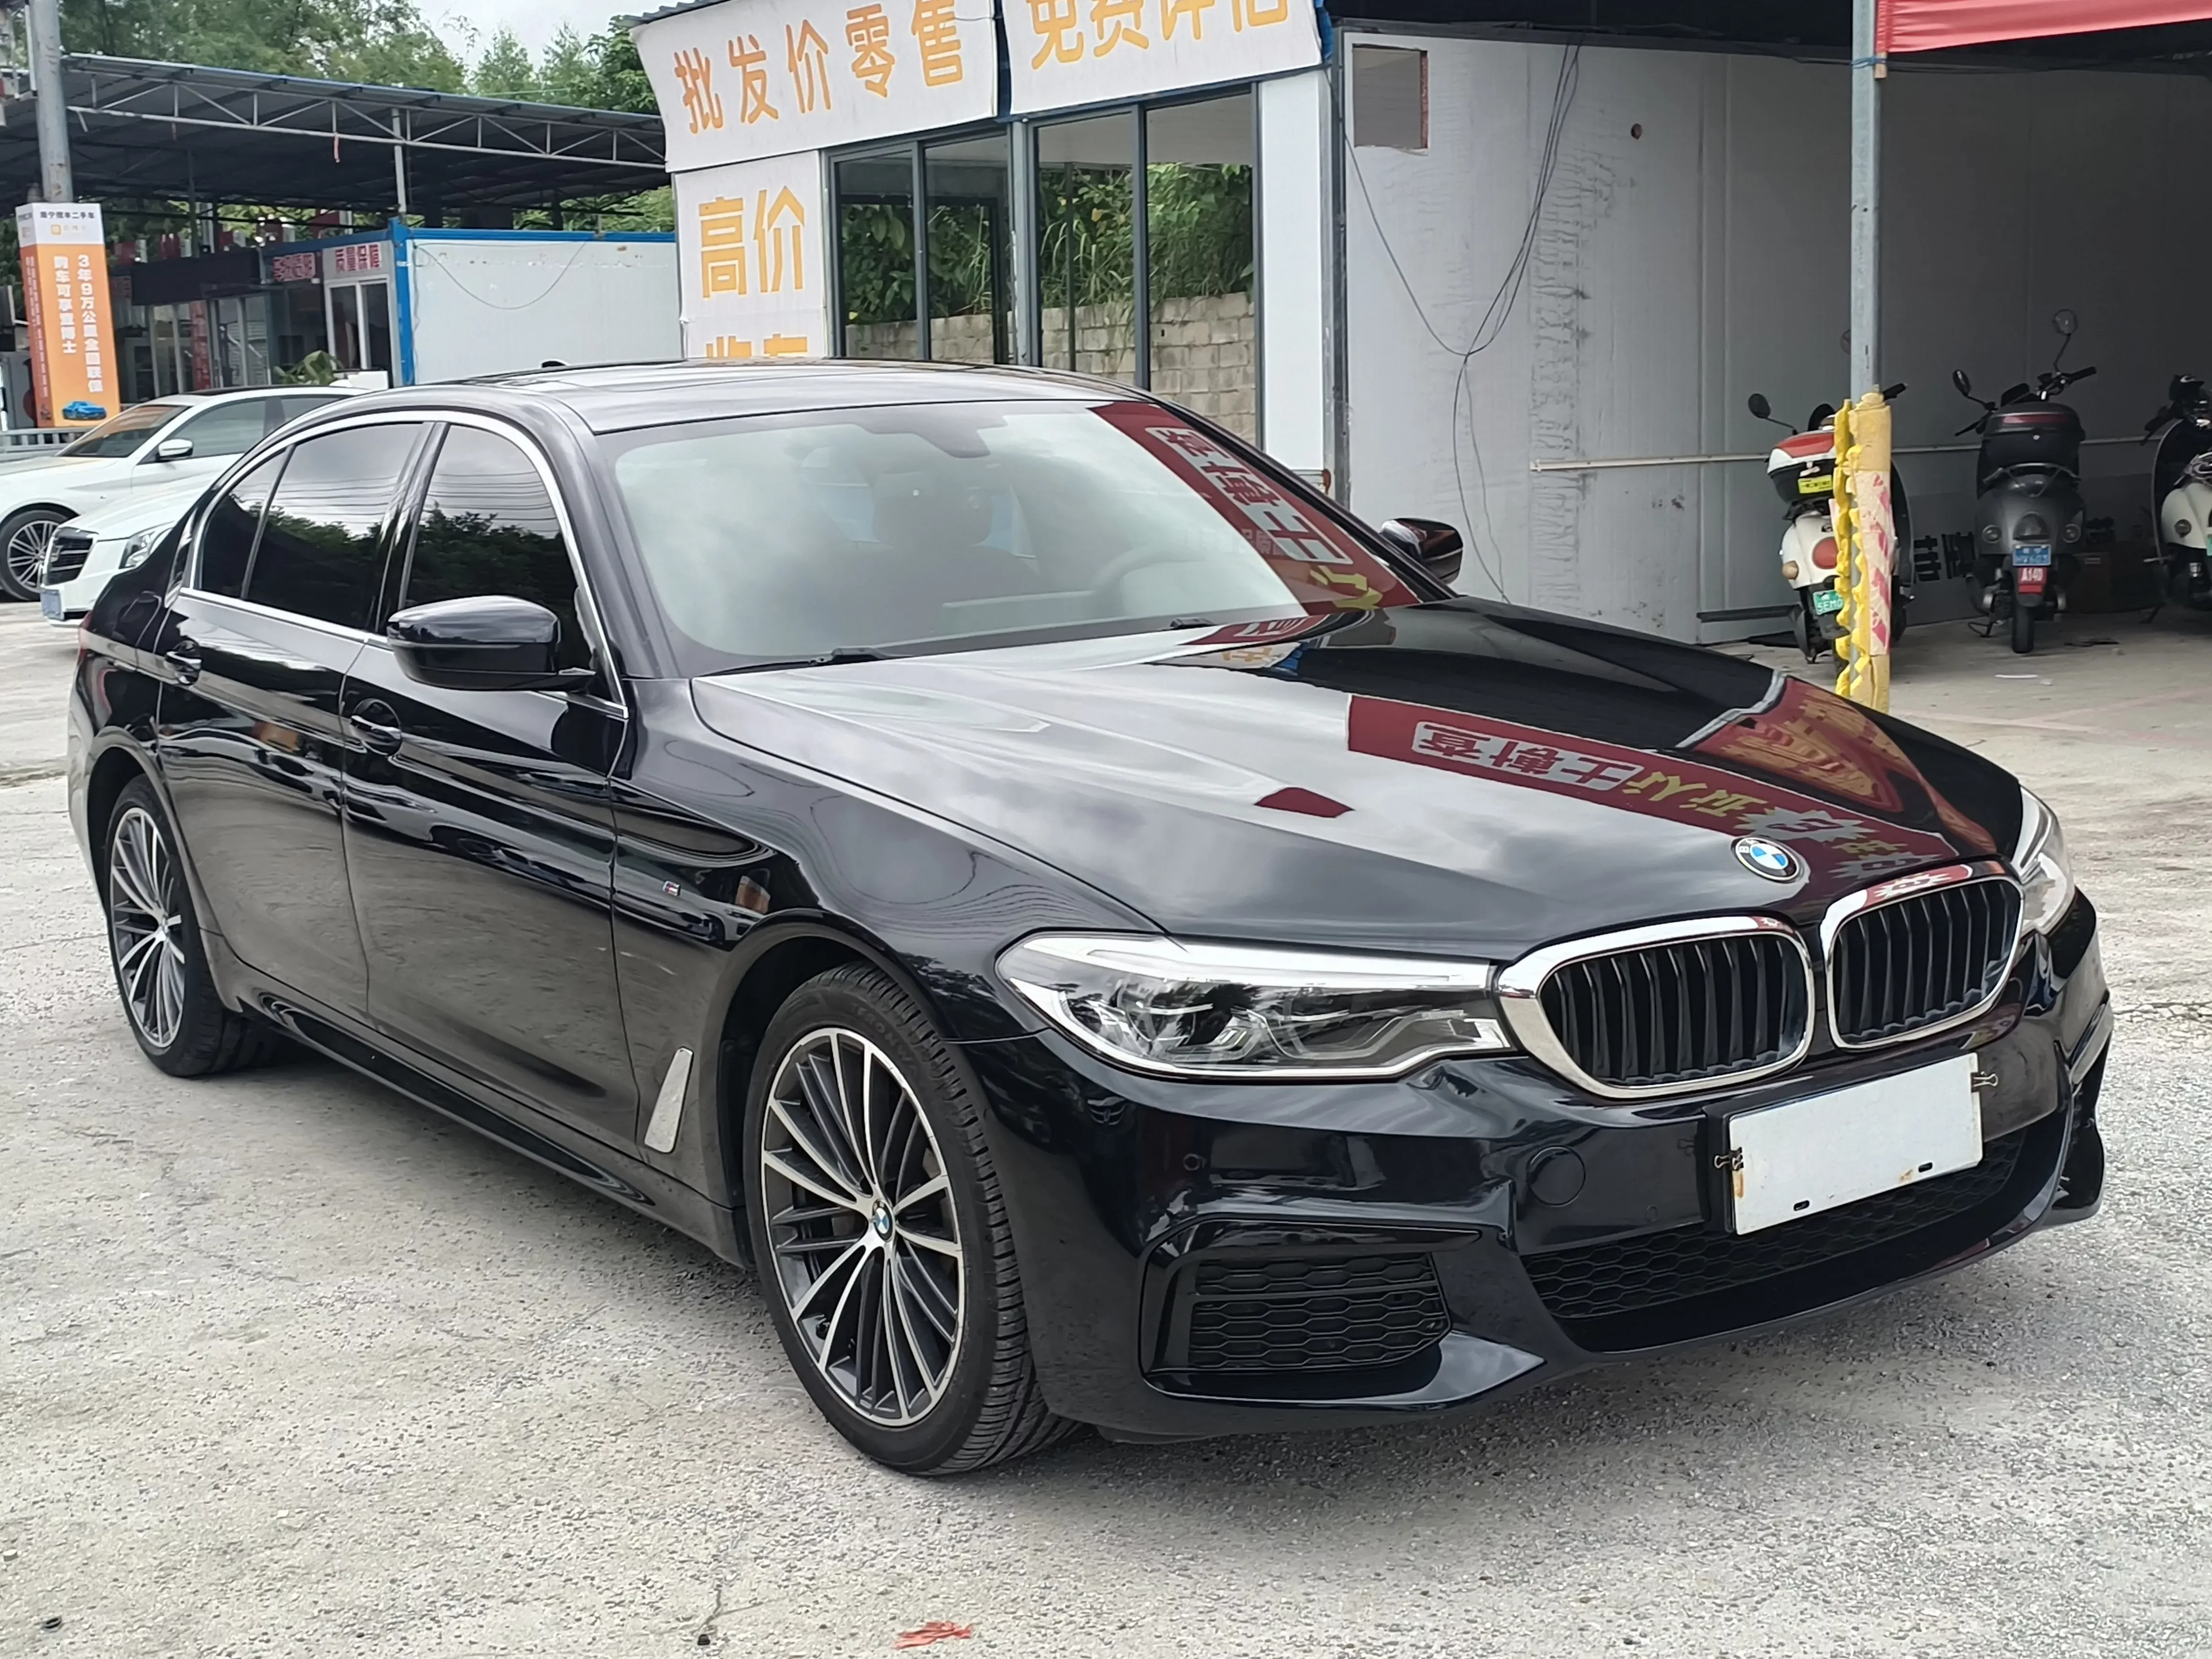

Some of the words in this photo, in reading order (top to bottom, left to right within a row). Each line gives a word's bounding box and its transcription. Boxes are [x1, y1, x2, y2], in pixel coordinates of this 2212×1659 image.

[674, 0, 963, 134] 批发价零售
[698, 186, 805, 299] 高价
